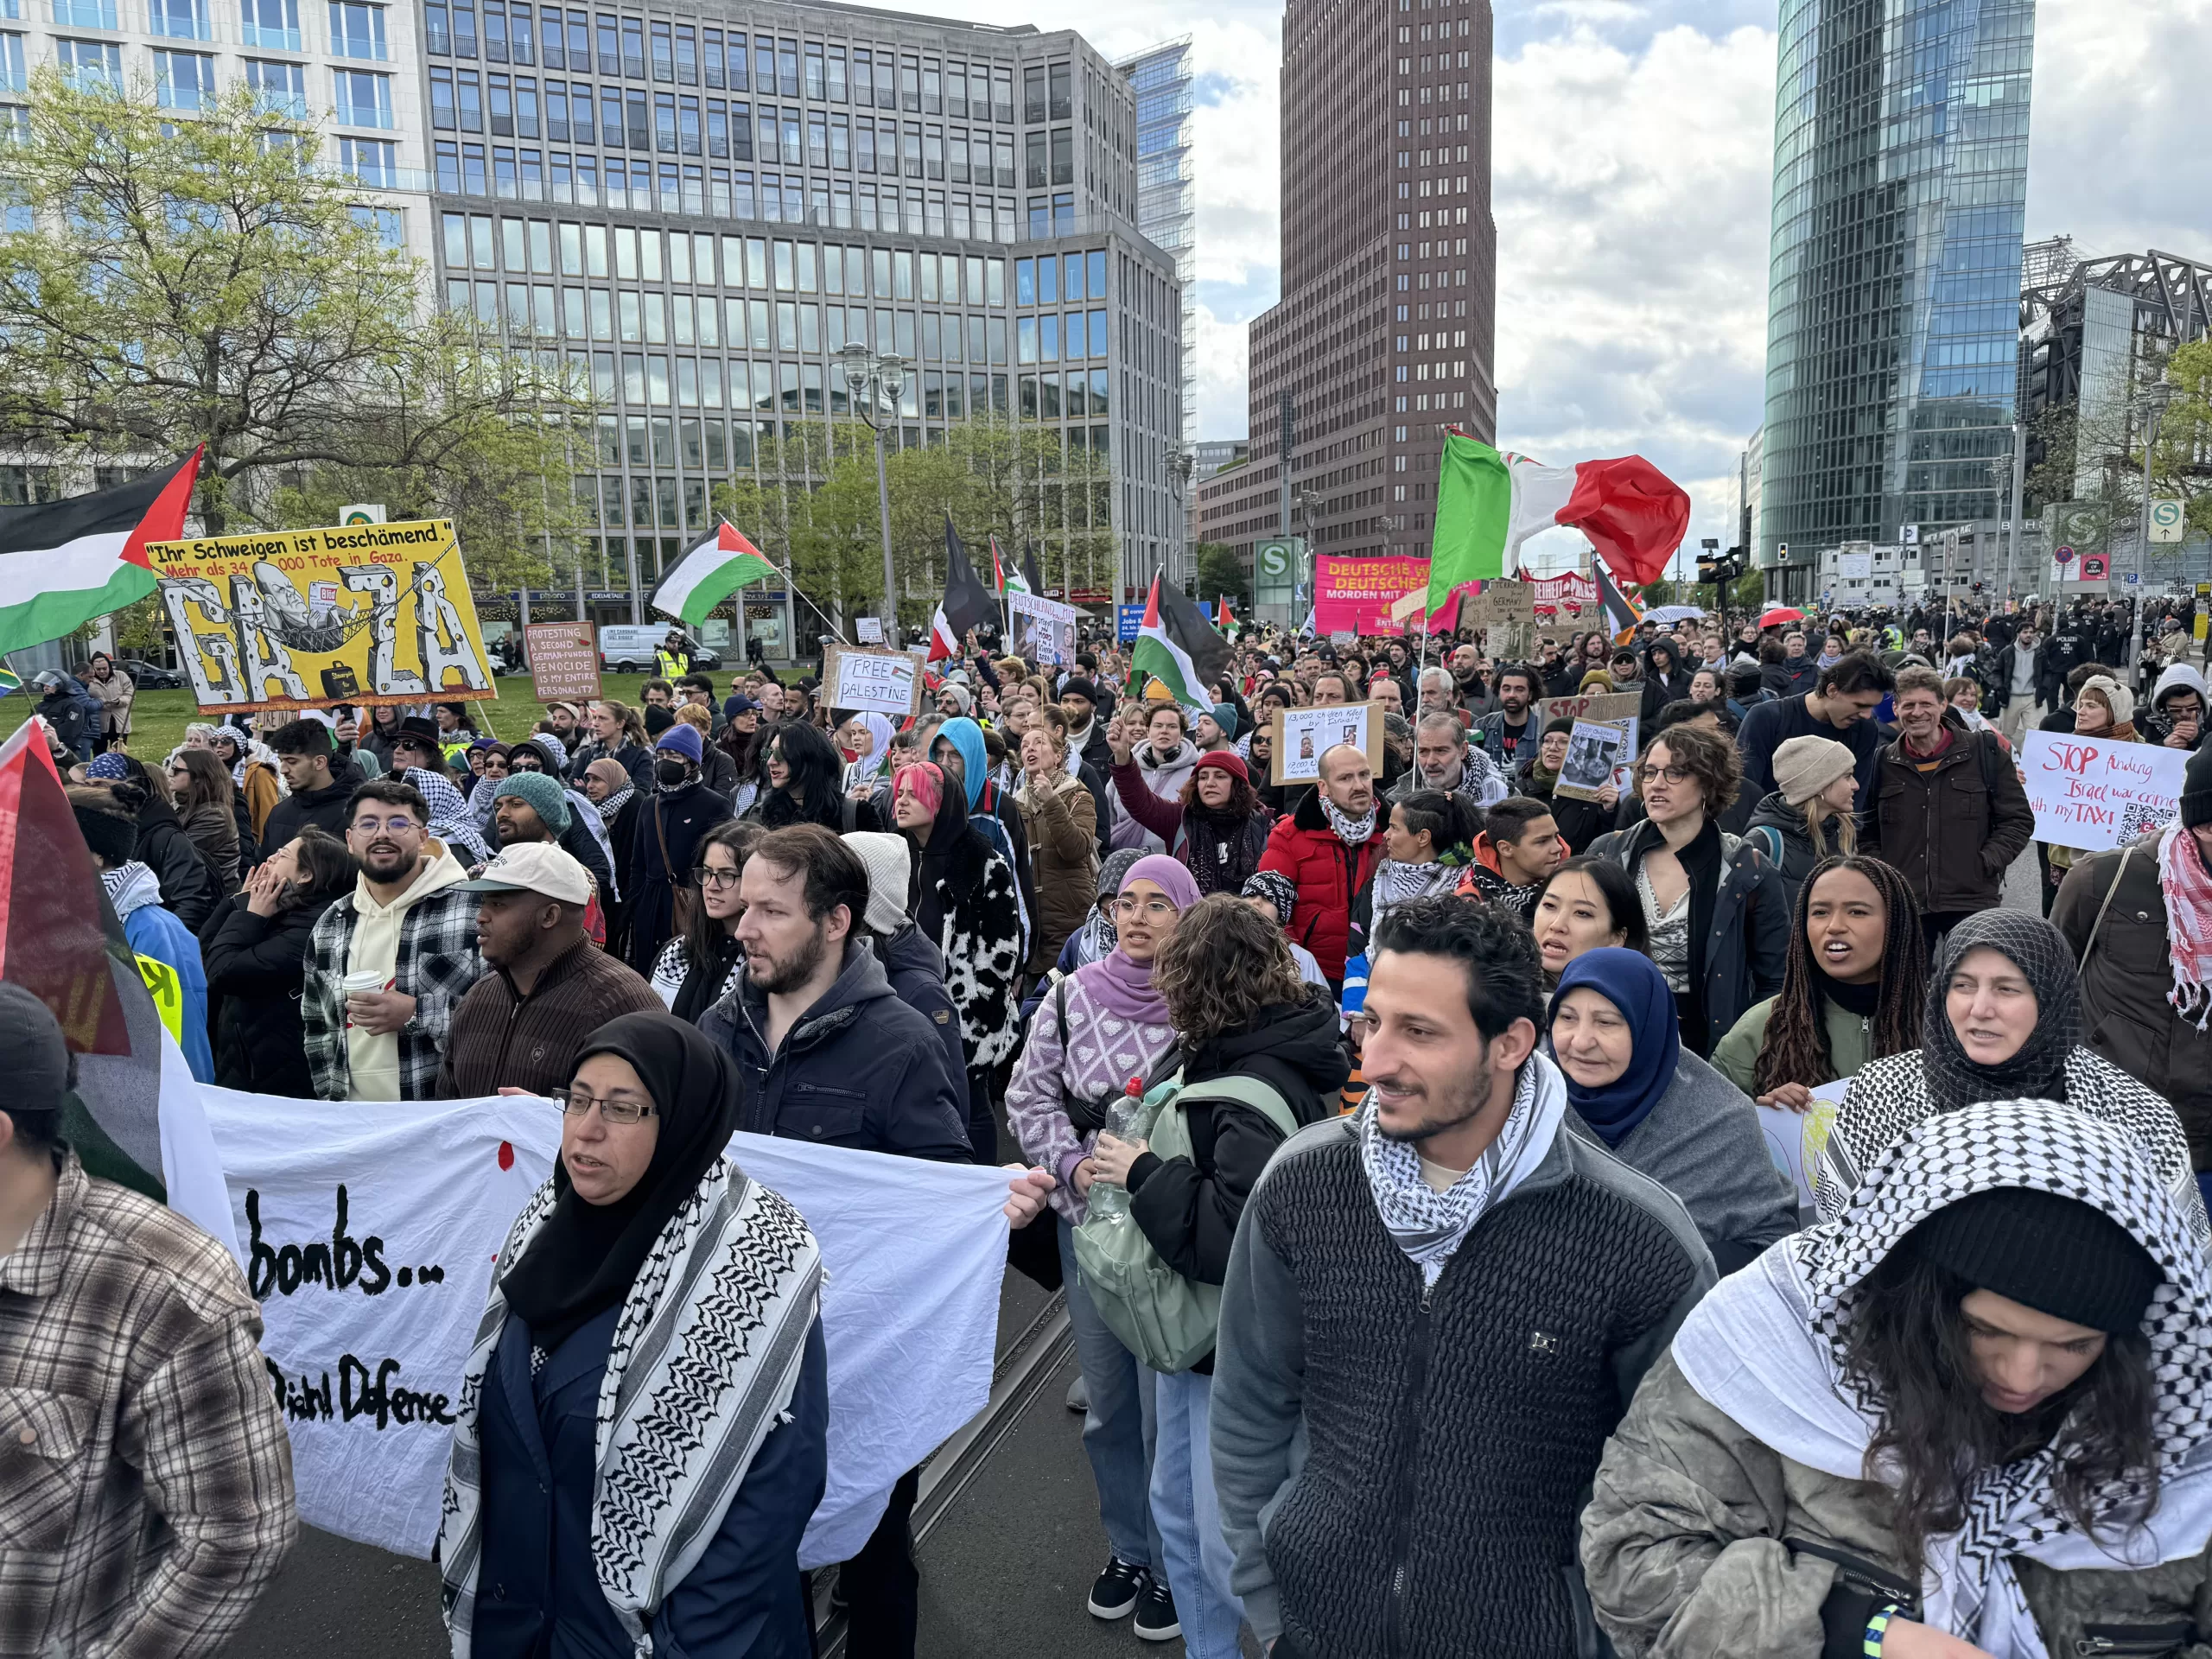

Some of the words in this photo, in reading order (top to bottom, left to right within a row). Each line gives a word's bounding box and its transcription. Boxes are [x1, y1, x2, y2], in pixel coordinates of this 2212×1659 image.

[194, 540, 287, 561] Schweigen
[293, 535, 317, 552] ist
[165, 563, 200, 577] Mehr
[207, 561, 226, 575] als
[308, 555, 342, 568] Tote
[348, 552, 360, 565] in
[370, 550, 408, 564] Gaza.
[1264, 546, 1286, 575] S
[1328, 562, 1410, 577] DEUTSCHE
[1326, 589, 1377, 600] MORDEN
[1380, 590, 1401, 600] MIT
[1492, 596, 1522, 606] GERMANY
[1009, 591, 1055, 616] DEUTSCHLAND
[1062, 607, 1076, 621] MIT
[158, 562, 490, 706] GAZA
[527, 627, 582, 639] PROTESTING
[531, 643, 537, 652] A
[540, 640, 574, 650] SECOND
[531, 650, 594, 661] GERMAN-FUNDED
[535, 661, 591, 672] GENOCIDE
[852, 658, 890, 679] FREE
[539, 675, 549, 683] IS
[550, 674, 562, 683] MY
[564, 672, 597, 683] ENTIRE
[537, 684, 594, 696] PERSONALITY
[1548, 697, 1590, 718] STOP
[1288, 713, 1313, 722] 13,000
[2042, 741, 2099, 775] STOP
[2105, 751, 2154, 785] funding
[2063, 776, 2108, 803] Israel
[2112, 787, 2137, 799] war
[2030, 796, 2047, 813] ith
[2054, 804, 2074, 823] my
[2070, 802, 2115, 834] TAX!
